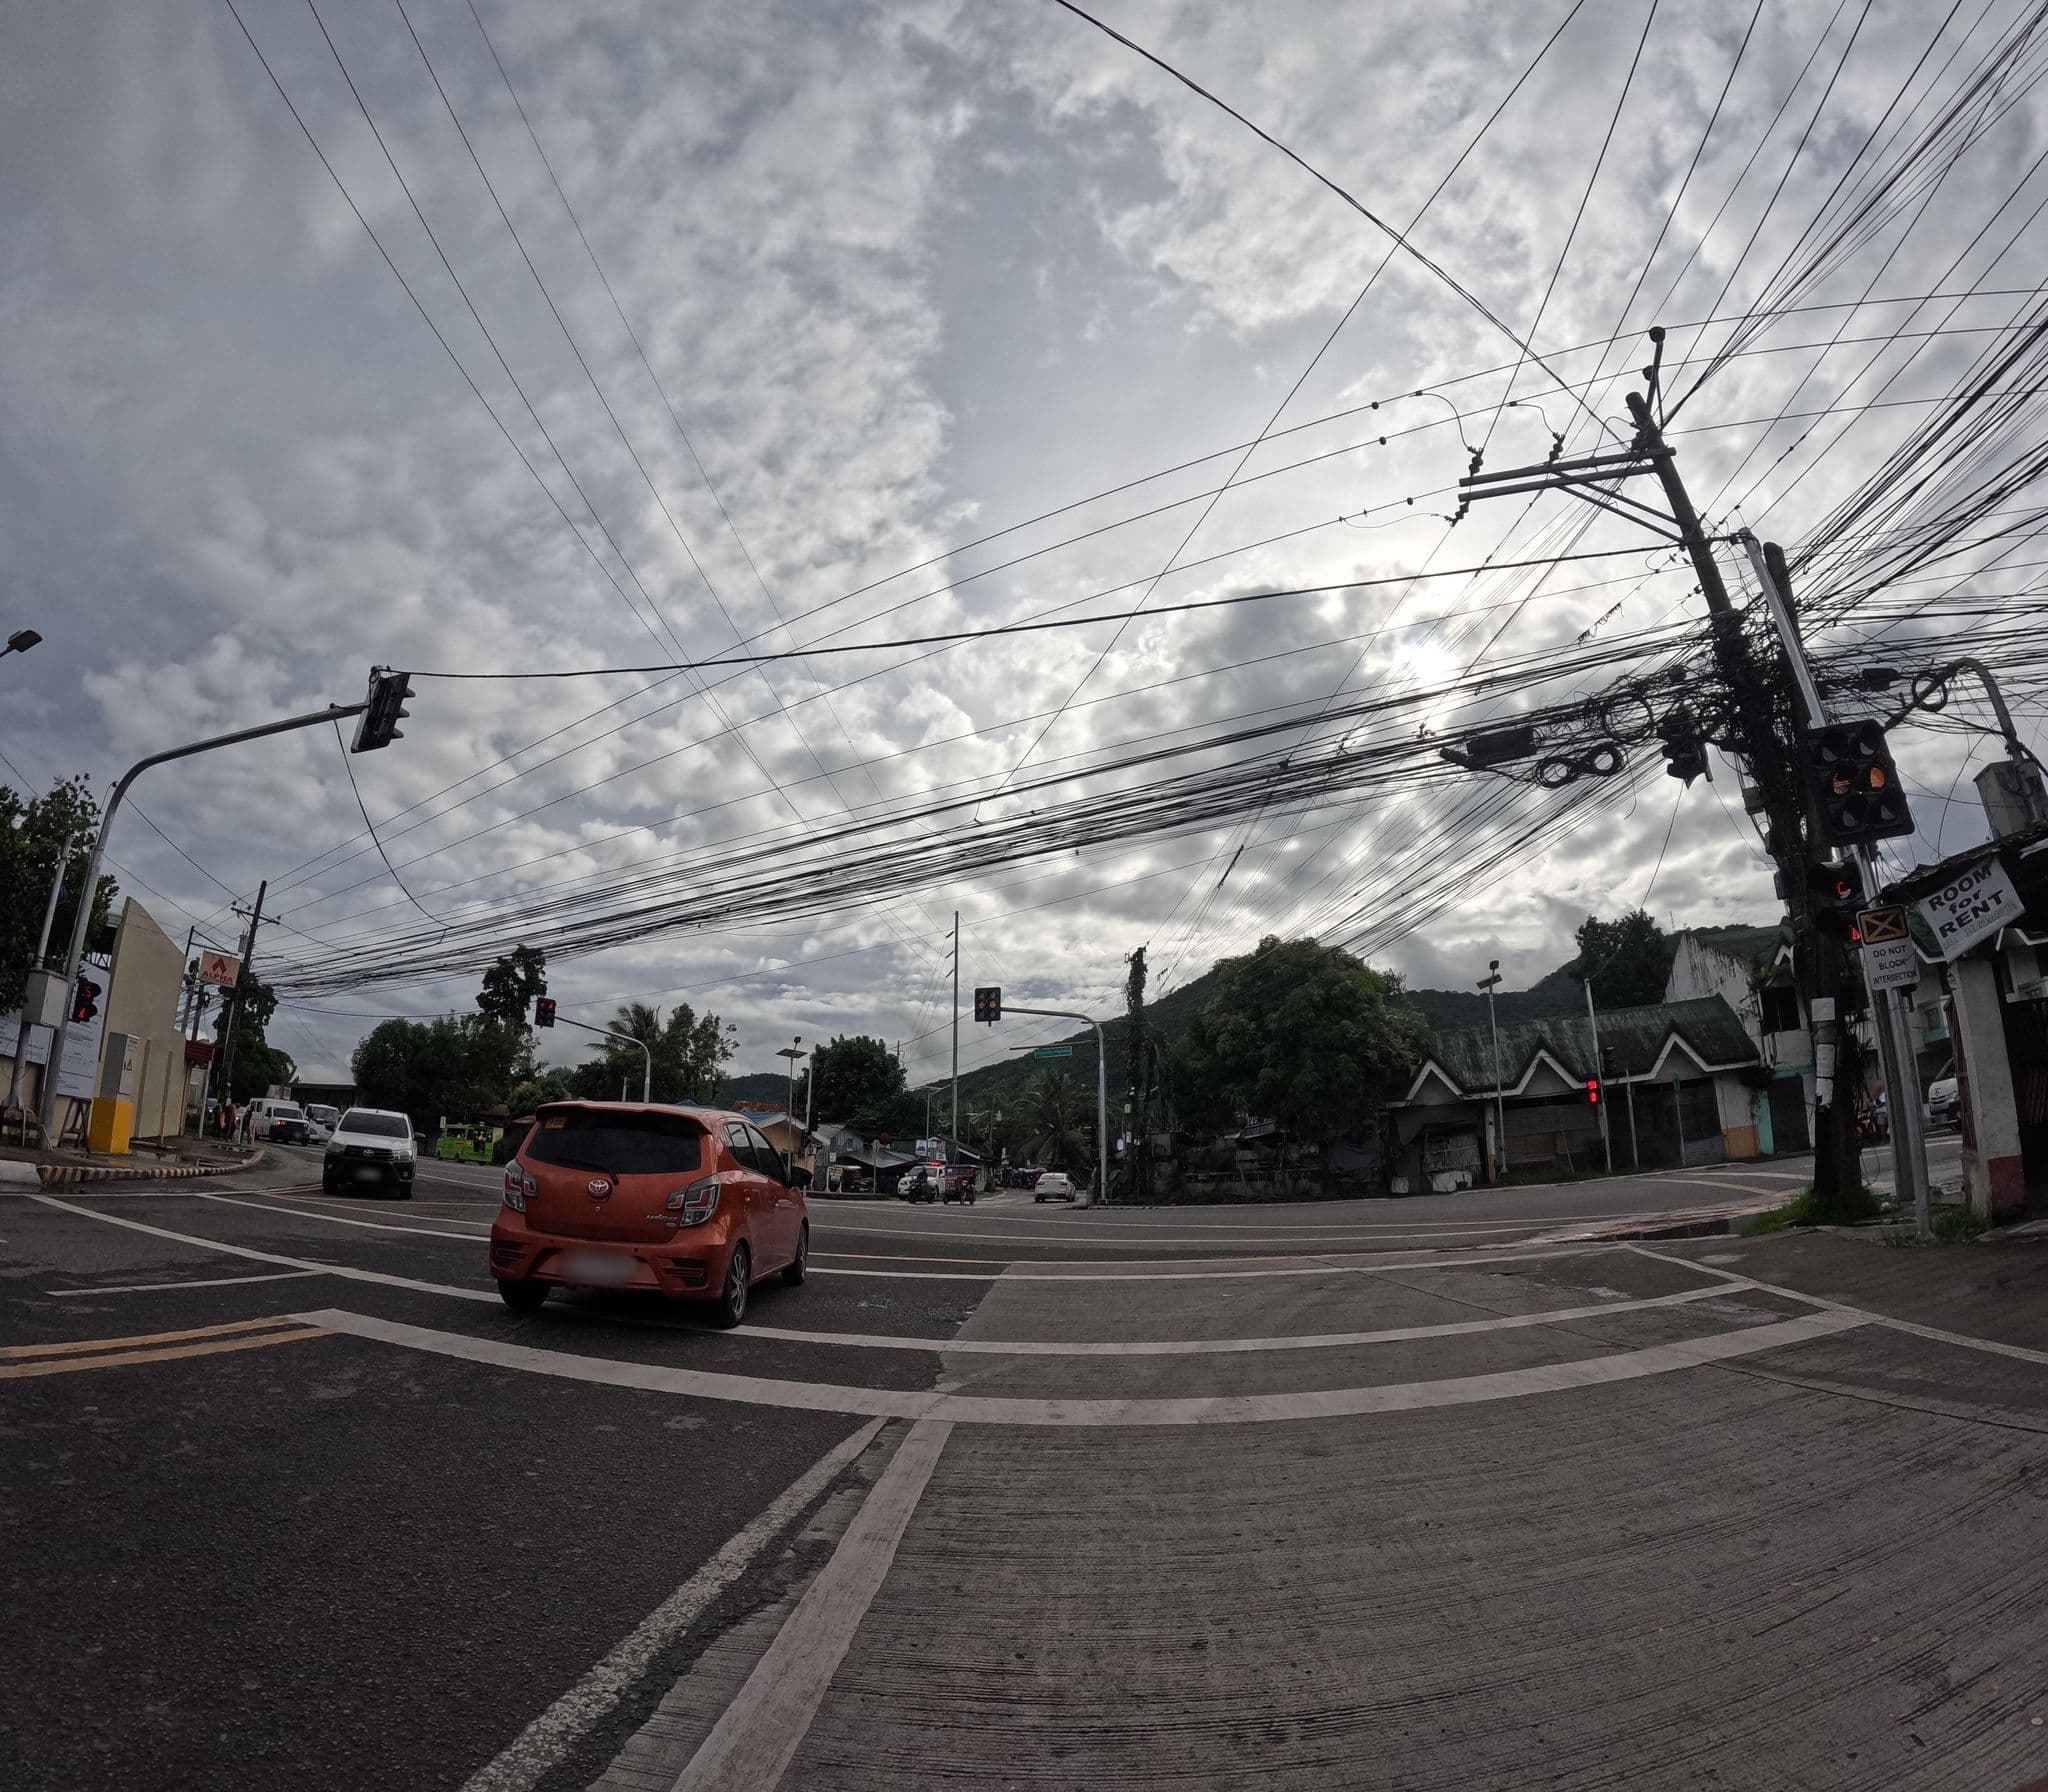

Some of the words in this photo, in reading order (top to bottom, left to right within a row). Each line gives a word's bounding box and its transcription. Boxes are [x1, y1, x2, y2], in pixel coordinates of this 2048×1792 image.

[1928, 864, 1992, 912] ROOM
[1949, 889, 1982, 914] for
[1939, 889, 2004, 938] RENT
[1873, 949, 1887, 958] DO
[1889, 944, 1906, 955] NOT
[1879, 959, 1906, 971] BLOCK
[202, 970, 233, 984] ALPHA
[1873, 970, 1918, 985] INTERSECTION
